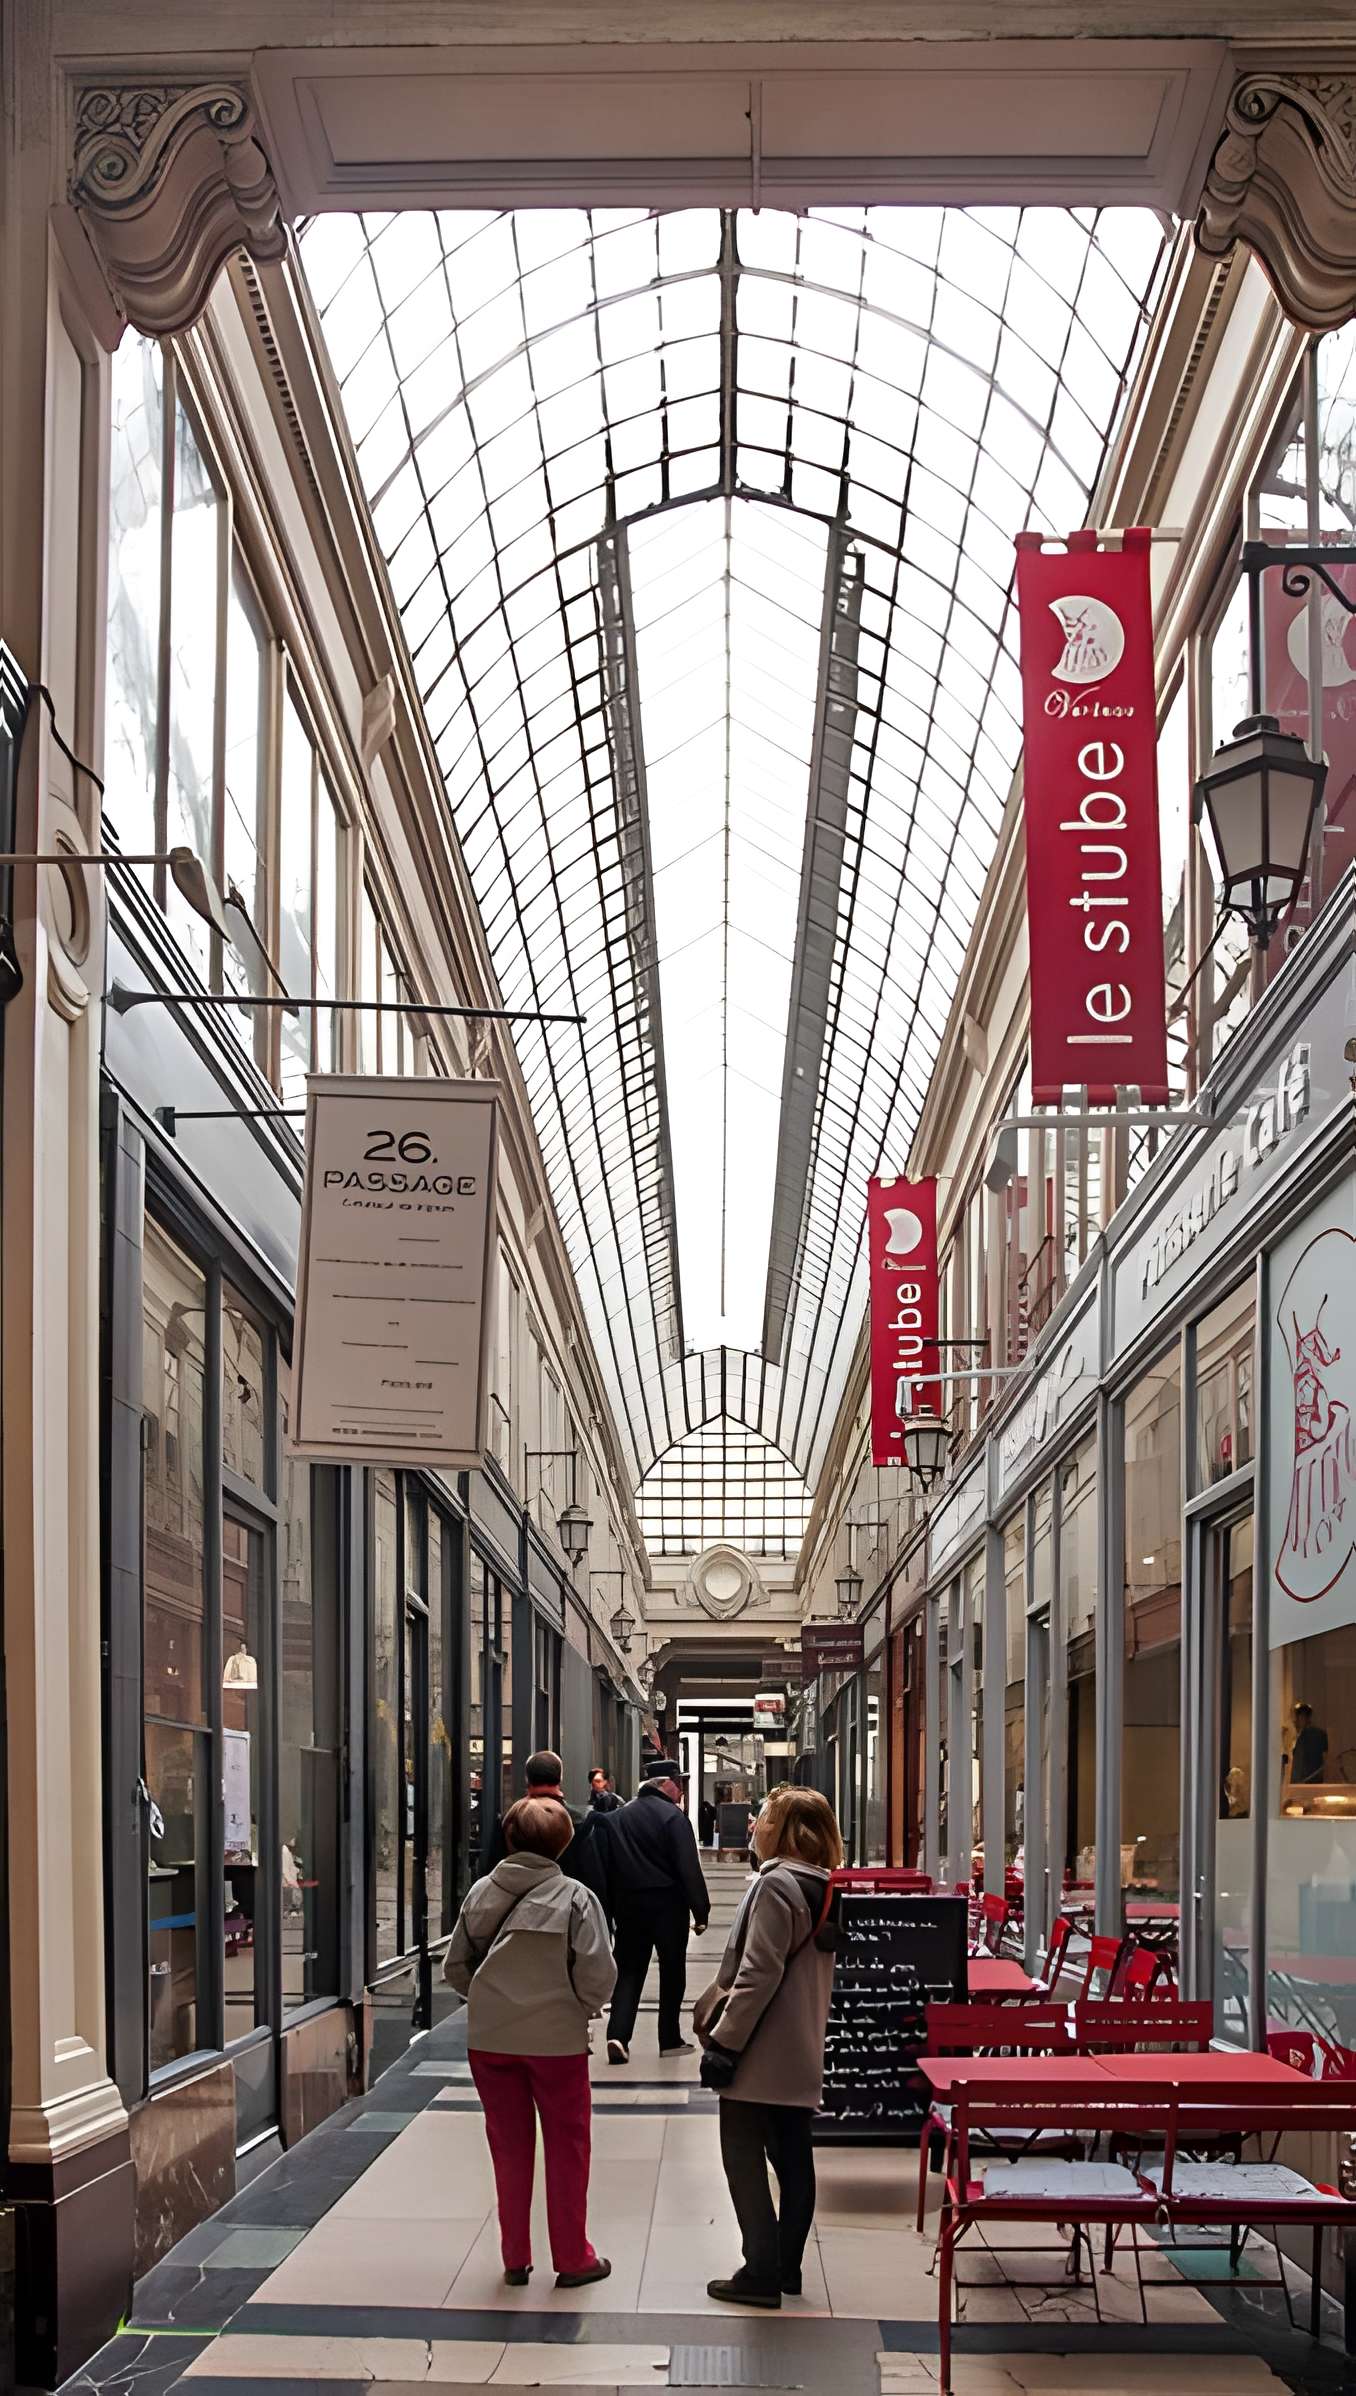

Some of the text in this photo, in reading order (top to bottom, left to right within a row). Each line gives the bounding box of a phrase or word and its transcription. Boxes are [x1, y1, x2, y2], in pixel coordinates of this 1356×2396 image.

[1059, 741, 1133, 1044] le stube
[363, 1130, 438, 1164] 26.
[324, 1170, 476, 1196] PASSAGE
